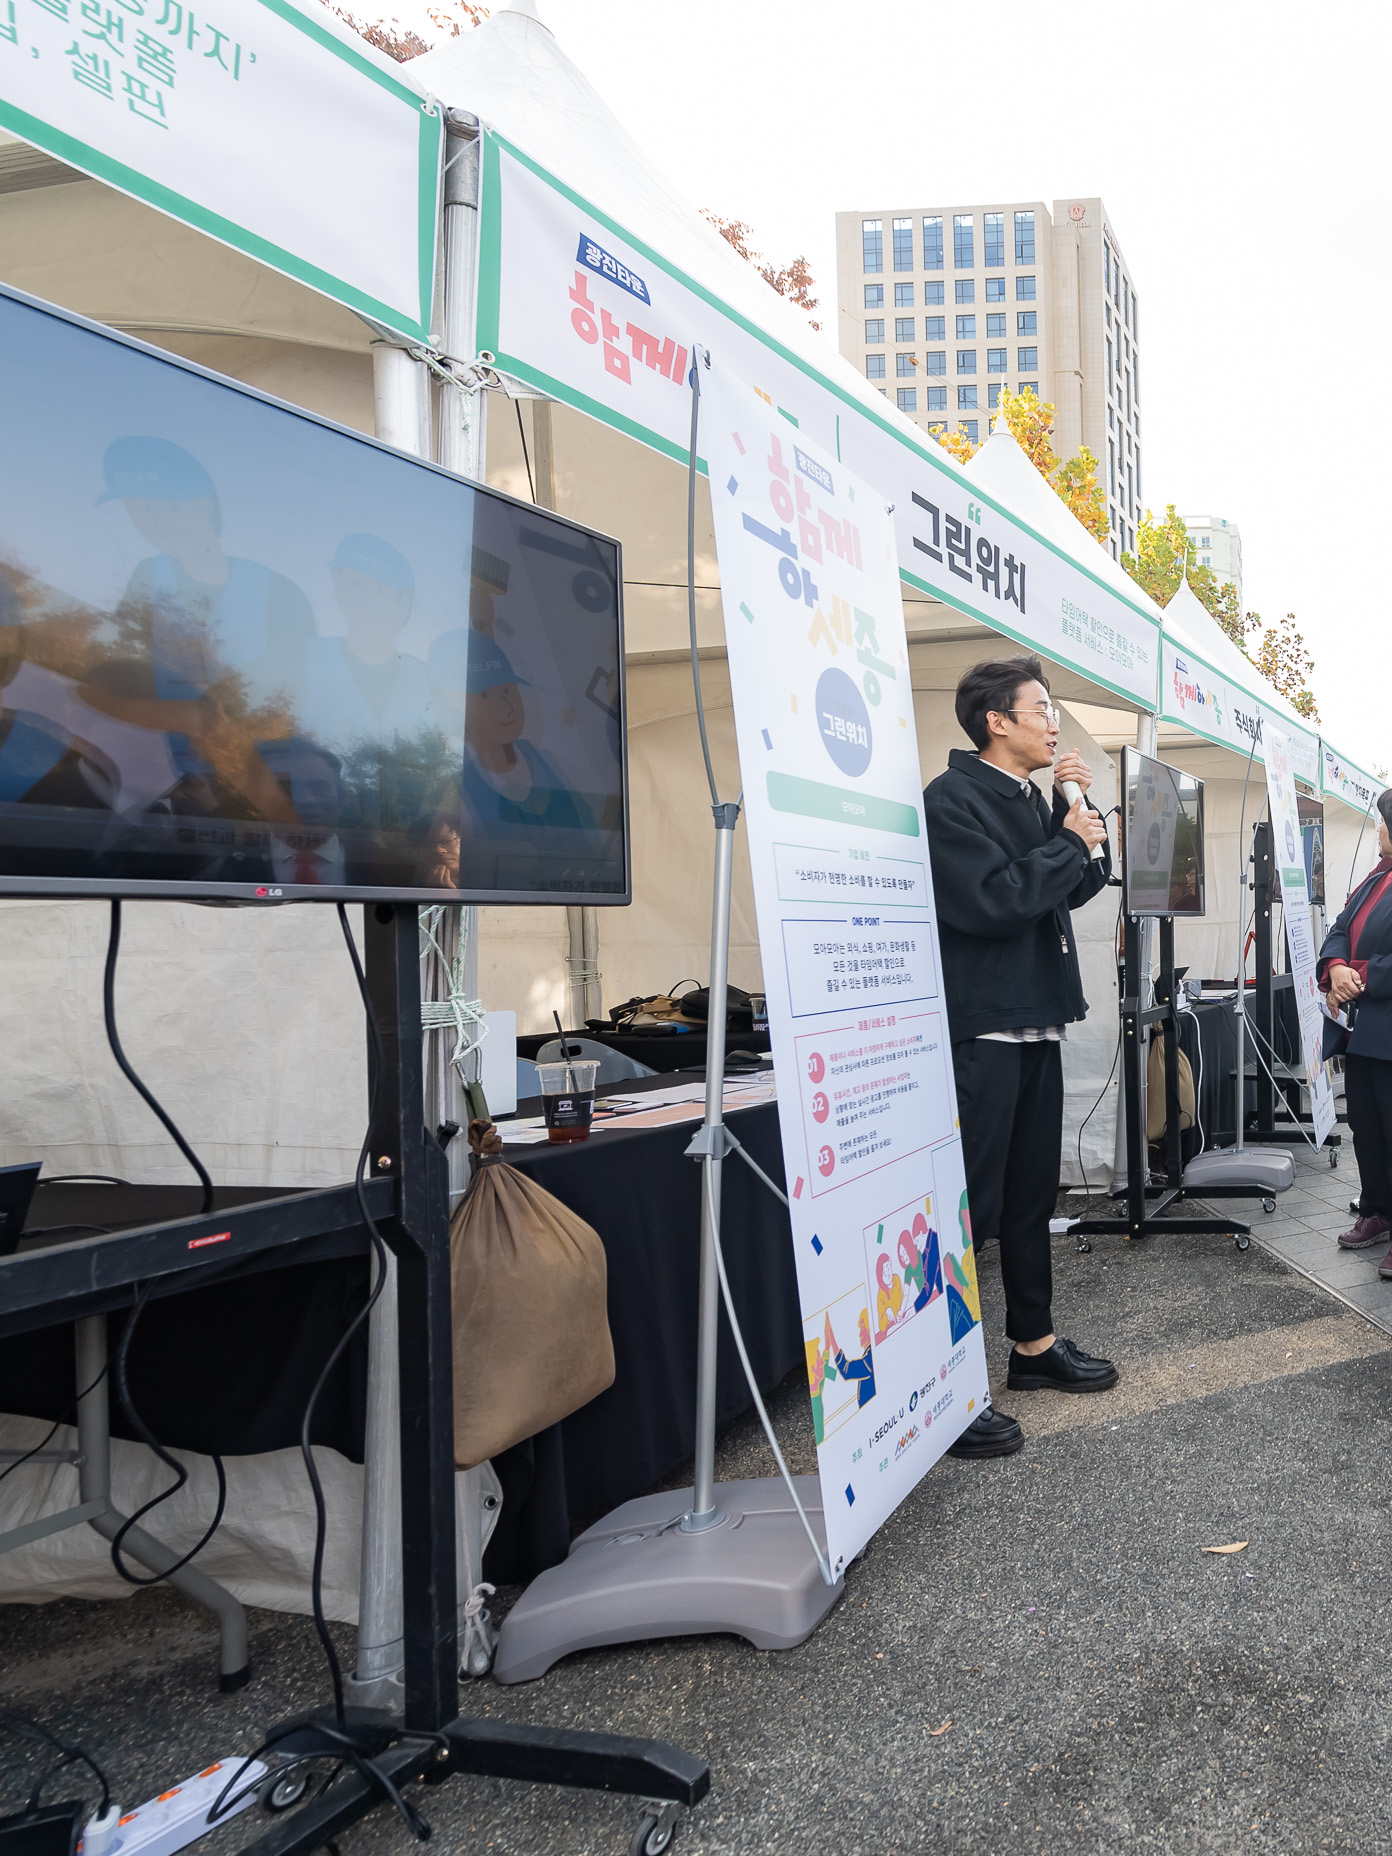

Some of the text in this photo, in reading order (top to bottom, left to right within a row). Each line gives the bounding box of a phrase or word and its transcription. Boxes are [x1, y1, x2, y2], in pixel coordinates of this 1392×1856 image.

[115, 0, 256, 81] 까지'
[64, 40, 169, 130] 셀핀
[585, 241, 647, 298] 광진타운
[568, 270, 700, 388] 함께
[797, 451, 832, 489] 광진타운
[911, 490, 1026, 615] 그린위치
[1061, 598, 1088, 629] 타임어택
[1091, 617, 1114, 644] 할인으로
[1117, 633, 1128, 652] 즐길
[1130, 643, 1136, 655] 수
[1062, 617, 1082, 643] 플랫폼
[1084, 631, 1103, 655] 서비스
[1109, 646, 1134, 671] 모아모아
[822, 712, 868, 749] 그린위치
[828, 872, 847, 885] 현명한
[849, 875, 866, 887] 소비를
[867, 876, 873, 887] 할
[874, 877, 880, 887] 수
[881, 877, 897, 889] 있도록
[852, 917, 880, 926] ONE POINT
[813, 942, 845, 955] 모아모아는
[890, 940, 910, 953] 문화생활
[833, 957, 905, 972] 모든 것을 타임어택 할인으로
[827, 979, 839, 992] 즐길
[841, 979, 847, 990] 수
[849, 978, 861, 989] 있는
[863, 975, 879, 988] 플랫폼
